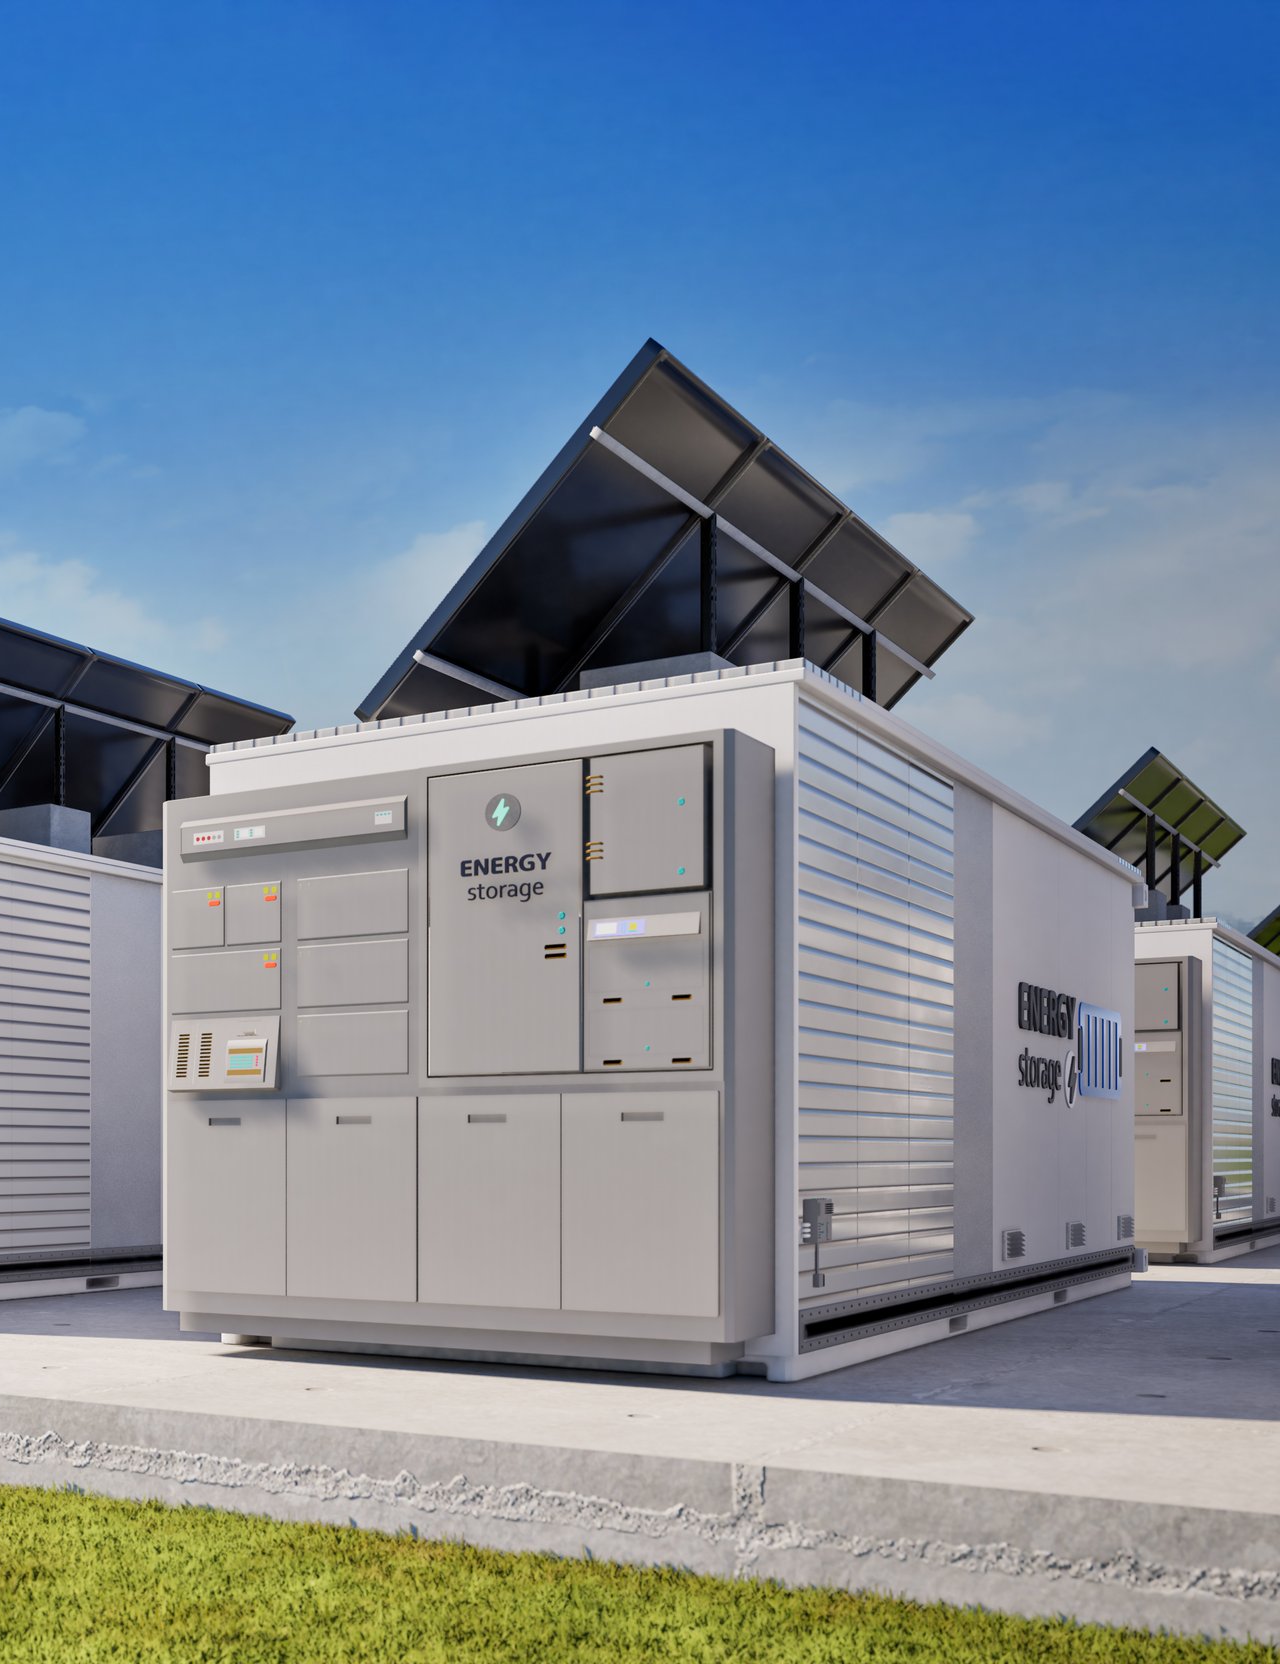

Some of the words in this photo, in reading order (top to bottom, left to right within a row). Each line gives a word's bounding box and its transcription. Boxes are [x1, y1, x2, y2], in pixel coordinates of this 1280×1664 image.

[460, 851, 552, 878] ENERGY
[467, 879, 545, 903] storage
[1018, 981, 1077, 1040] ENERGY
[1018, 1047, 1062, 1104] storage
